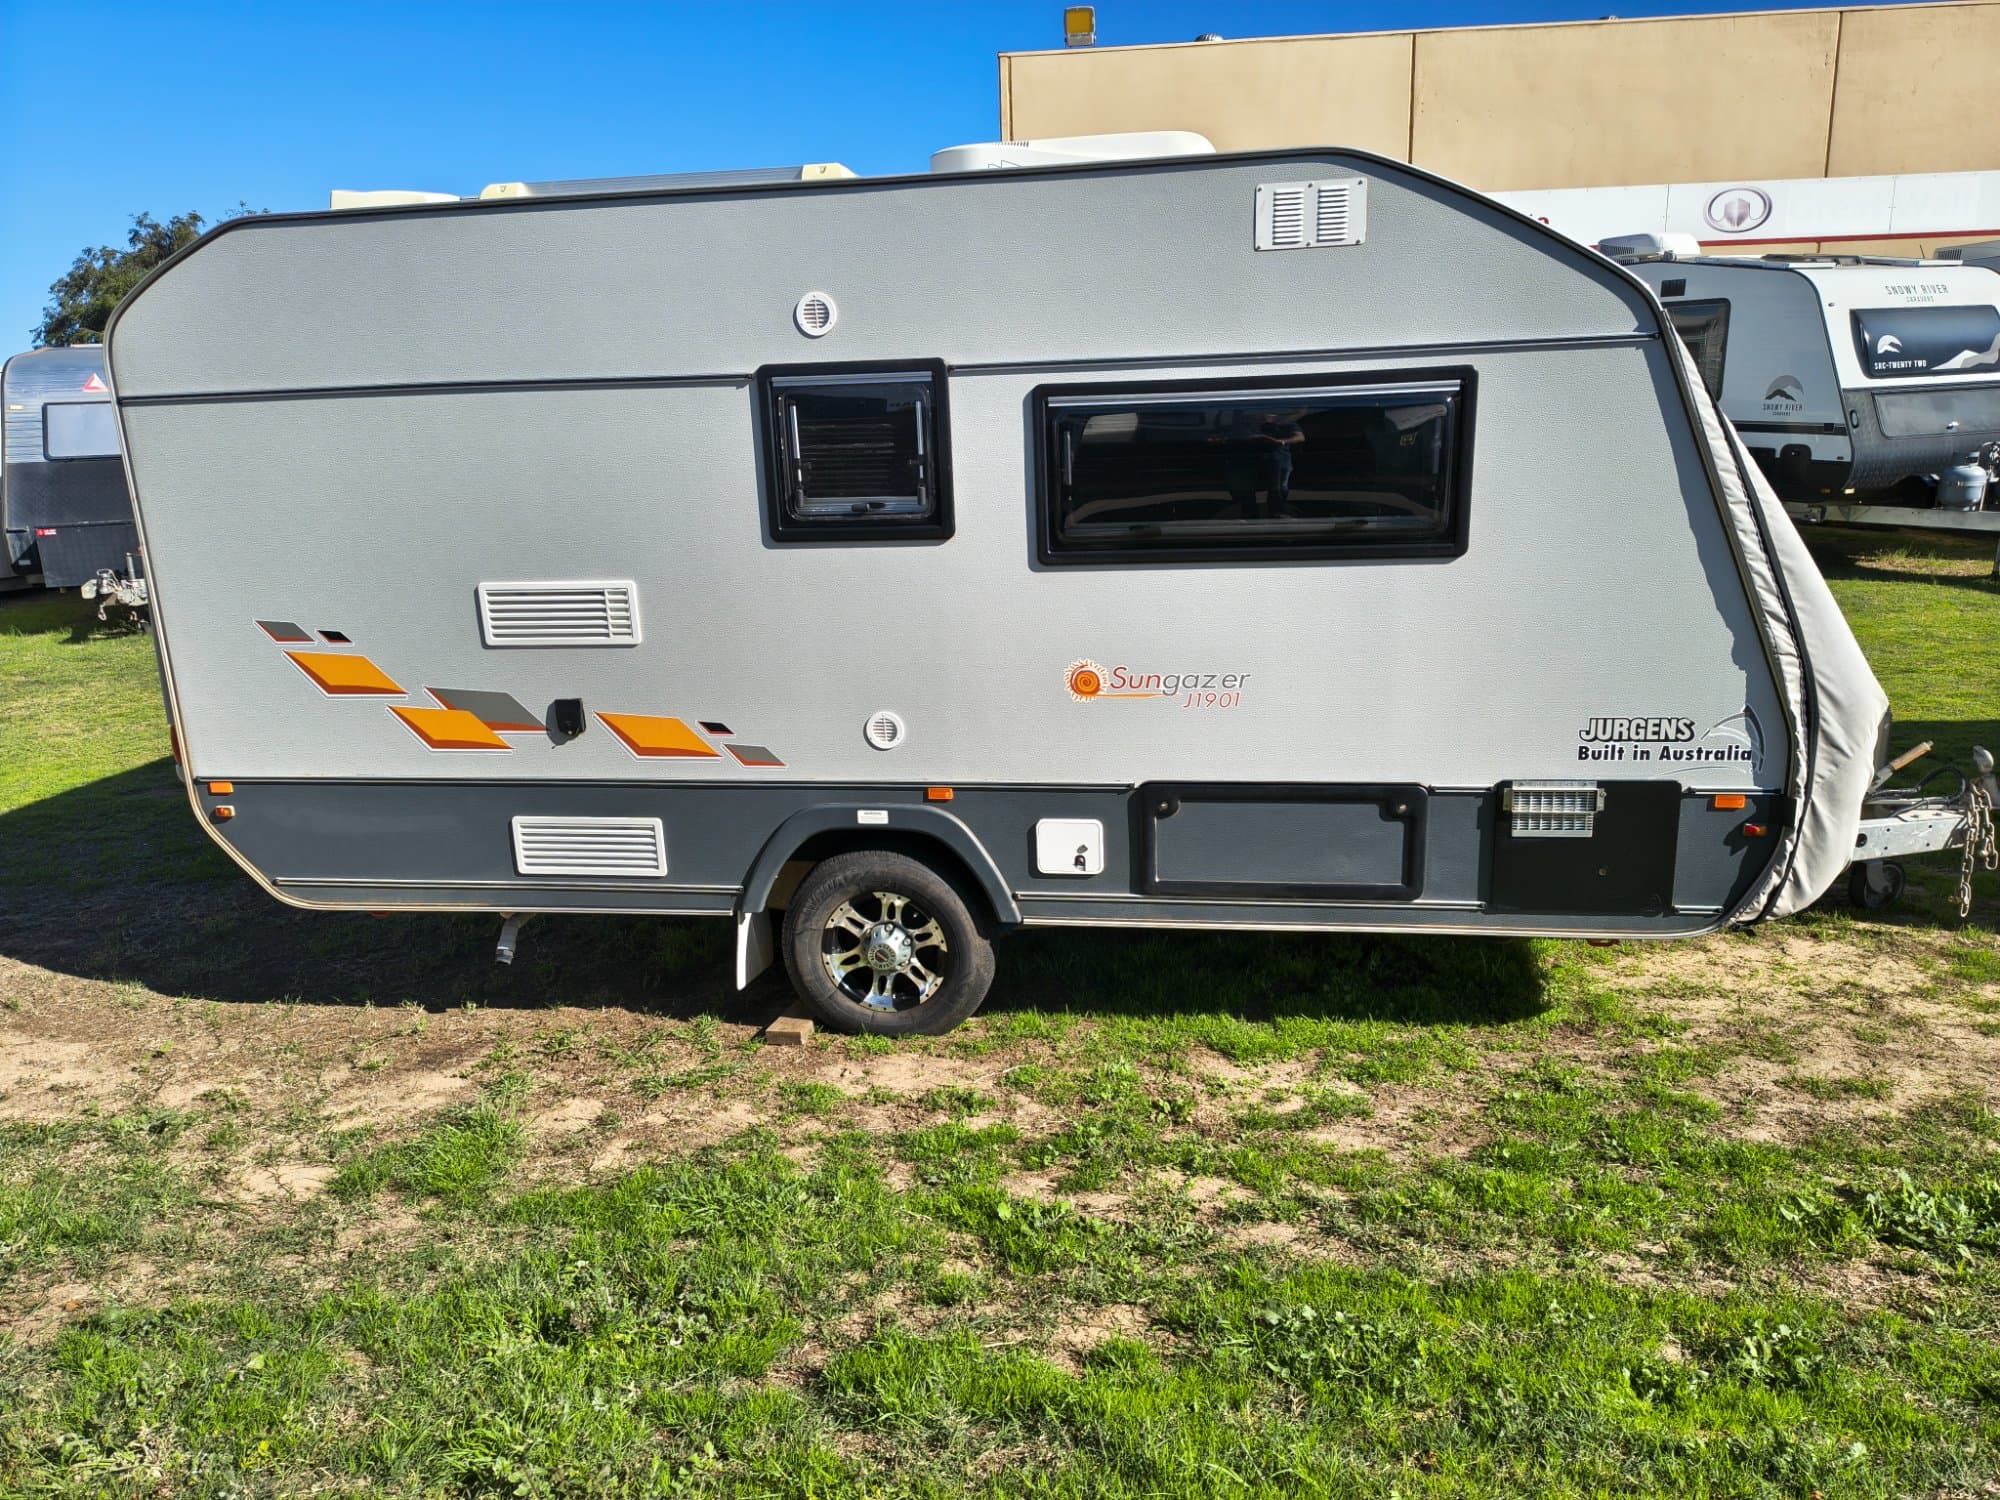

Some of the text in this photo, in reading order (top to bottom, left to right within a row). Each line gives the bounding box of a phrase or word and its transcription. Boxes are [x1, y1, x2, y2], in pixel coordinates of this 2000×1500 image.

[1885, 284, 1949, 295] SNOWY RIVER
[1914, 359, 1927, 368] TWO
[1110, 666, 1251, 696] Sungazer
[1183, 692, 1240, 708] J1901
[1579, 717, 1695, 742] JURGENS
[1578, 744, 1752, 761] Built in Australia
